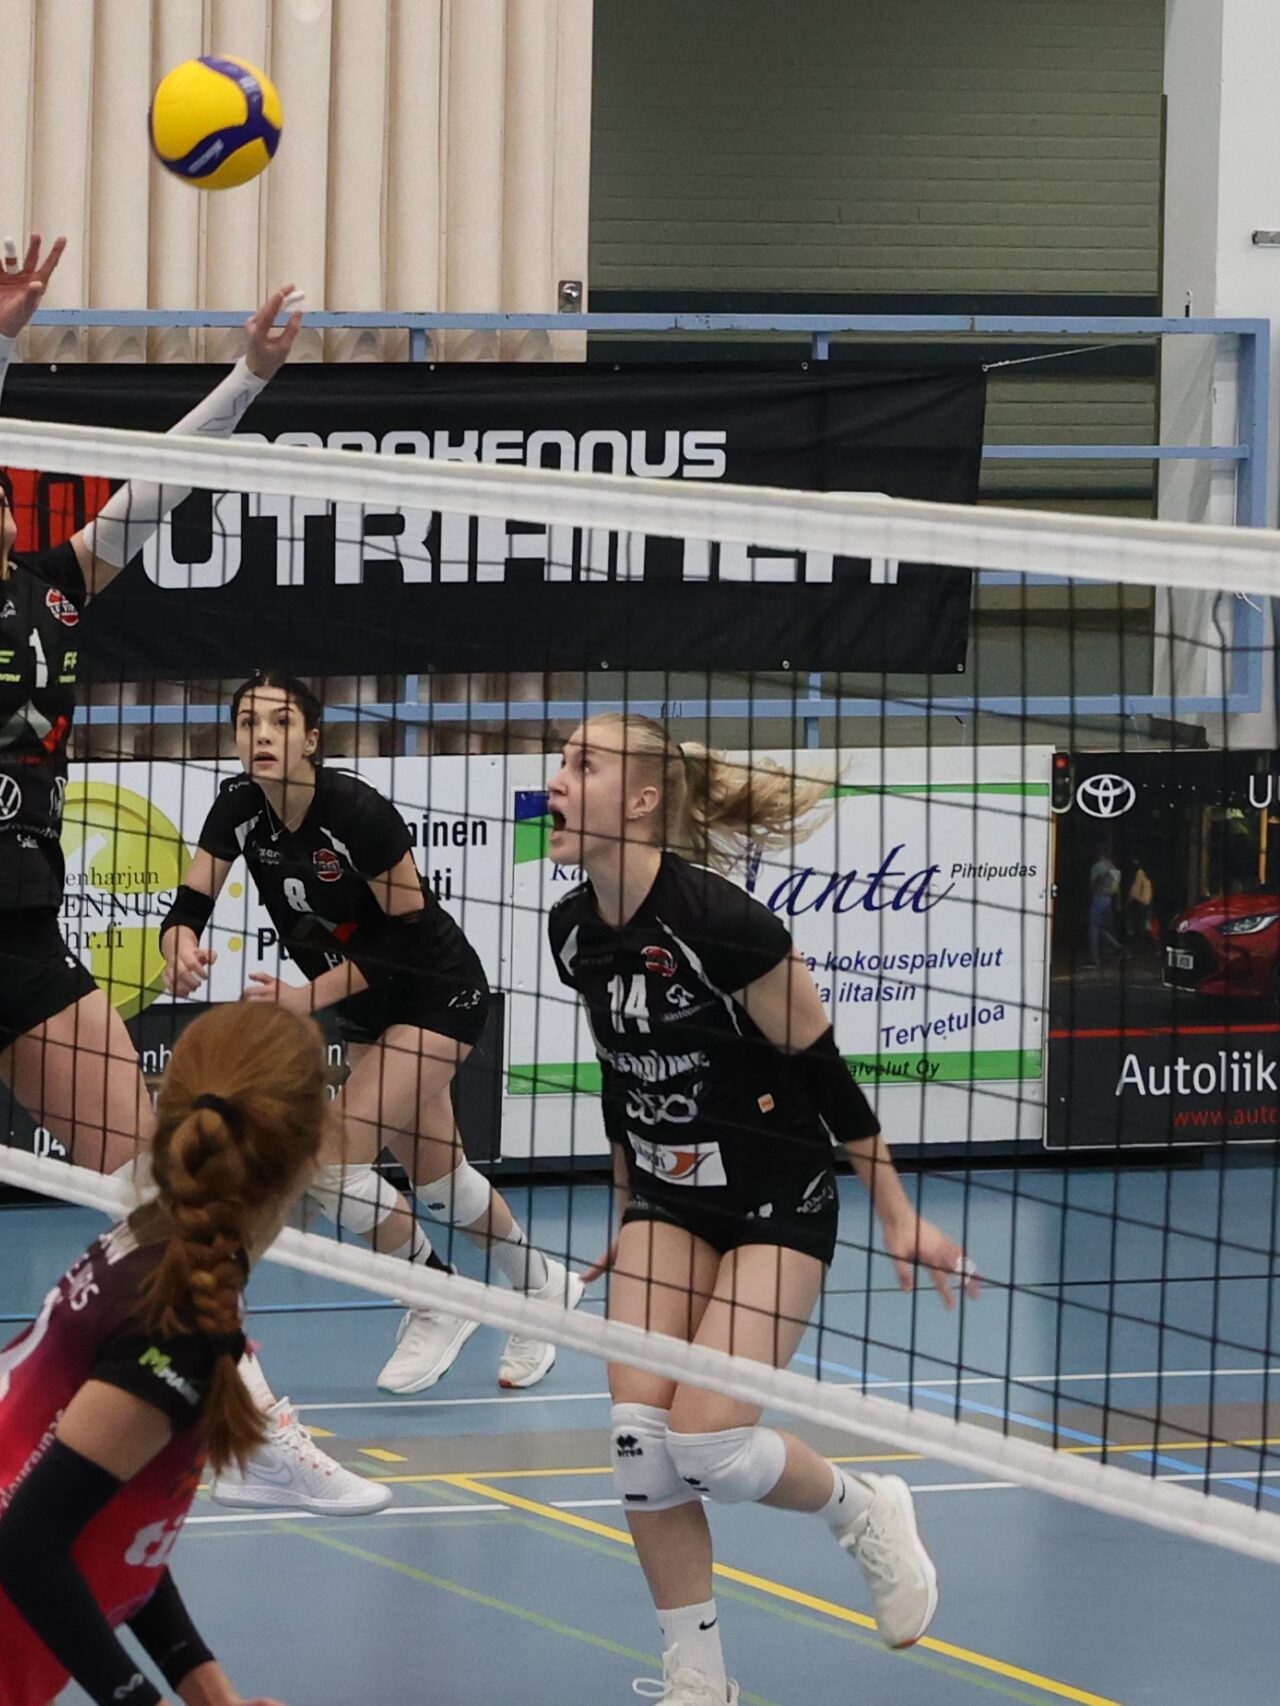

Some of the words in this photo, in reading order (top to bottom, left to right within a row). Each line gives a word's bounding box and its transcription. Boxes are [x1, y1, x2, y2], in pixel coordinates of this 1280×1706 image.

[65, 866, 160, 887] enharjun
[746, 842, 956, 917] anta
[951, 863, 1037, 879] Pihtipudas
[56, 890, 173, 919] ENNUS
[283, 877, 313, 913] 8
[61, 921, 124, 950] hr.fi
[823, 948, 1003, 975] kokouspalvelut
[606, 974, 651, 1034] 14
[839, 983, 916, 1003] iltaisin
[881, 1004, 1006, 1049] Tervetuloa
[915, 1058, 940, 1078] Oy
[1115, 1049, 1278, 1096] Autoliik
